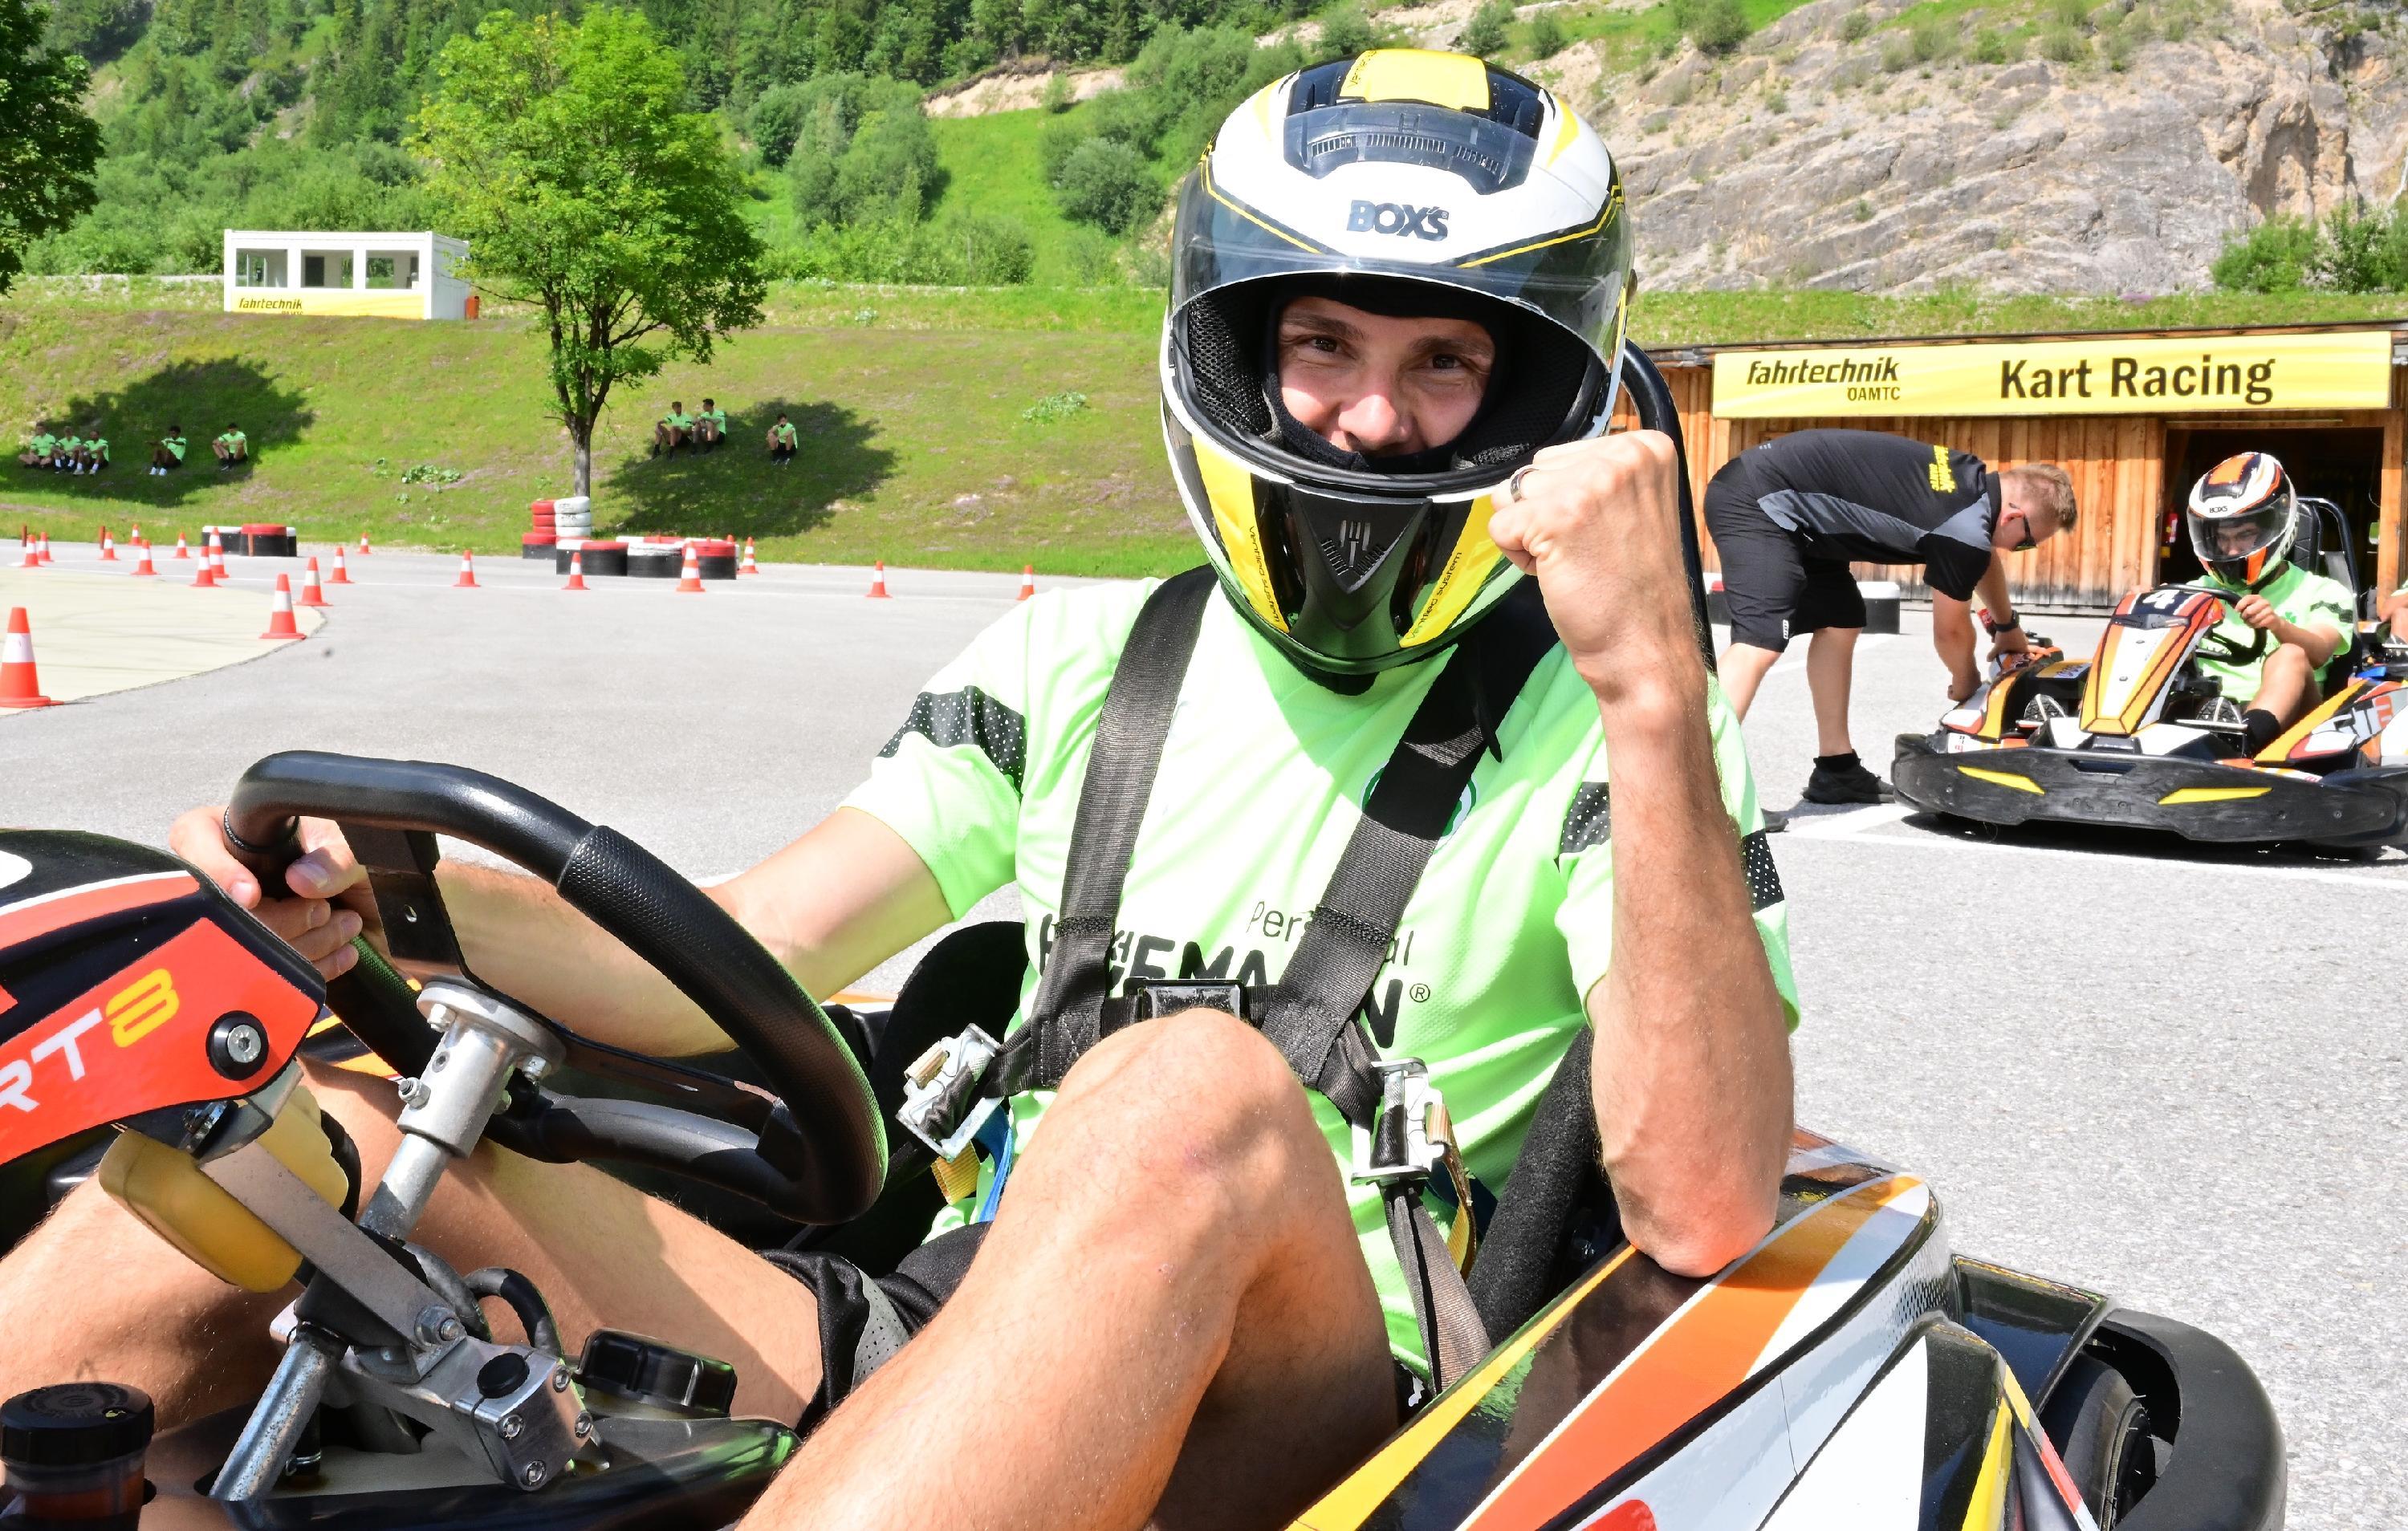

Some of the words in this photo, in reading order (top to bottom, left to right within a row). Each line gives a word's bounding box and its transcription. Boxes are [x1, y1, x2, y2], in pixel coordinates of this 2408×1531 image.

[238, 298, 303, 310] fahrtechnik
[1746, 357, 1900, 385] fahrtechnik
[2000, 359, 2093, 399] Kart
[2111, 354, 2276, 405] Racing
